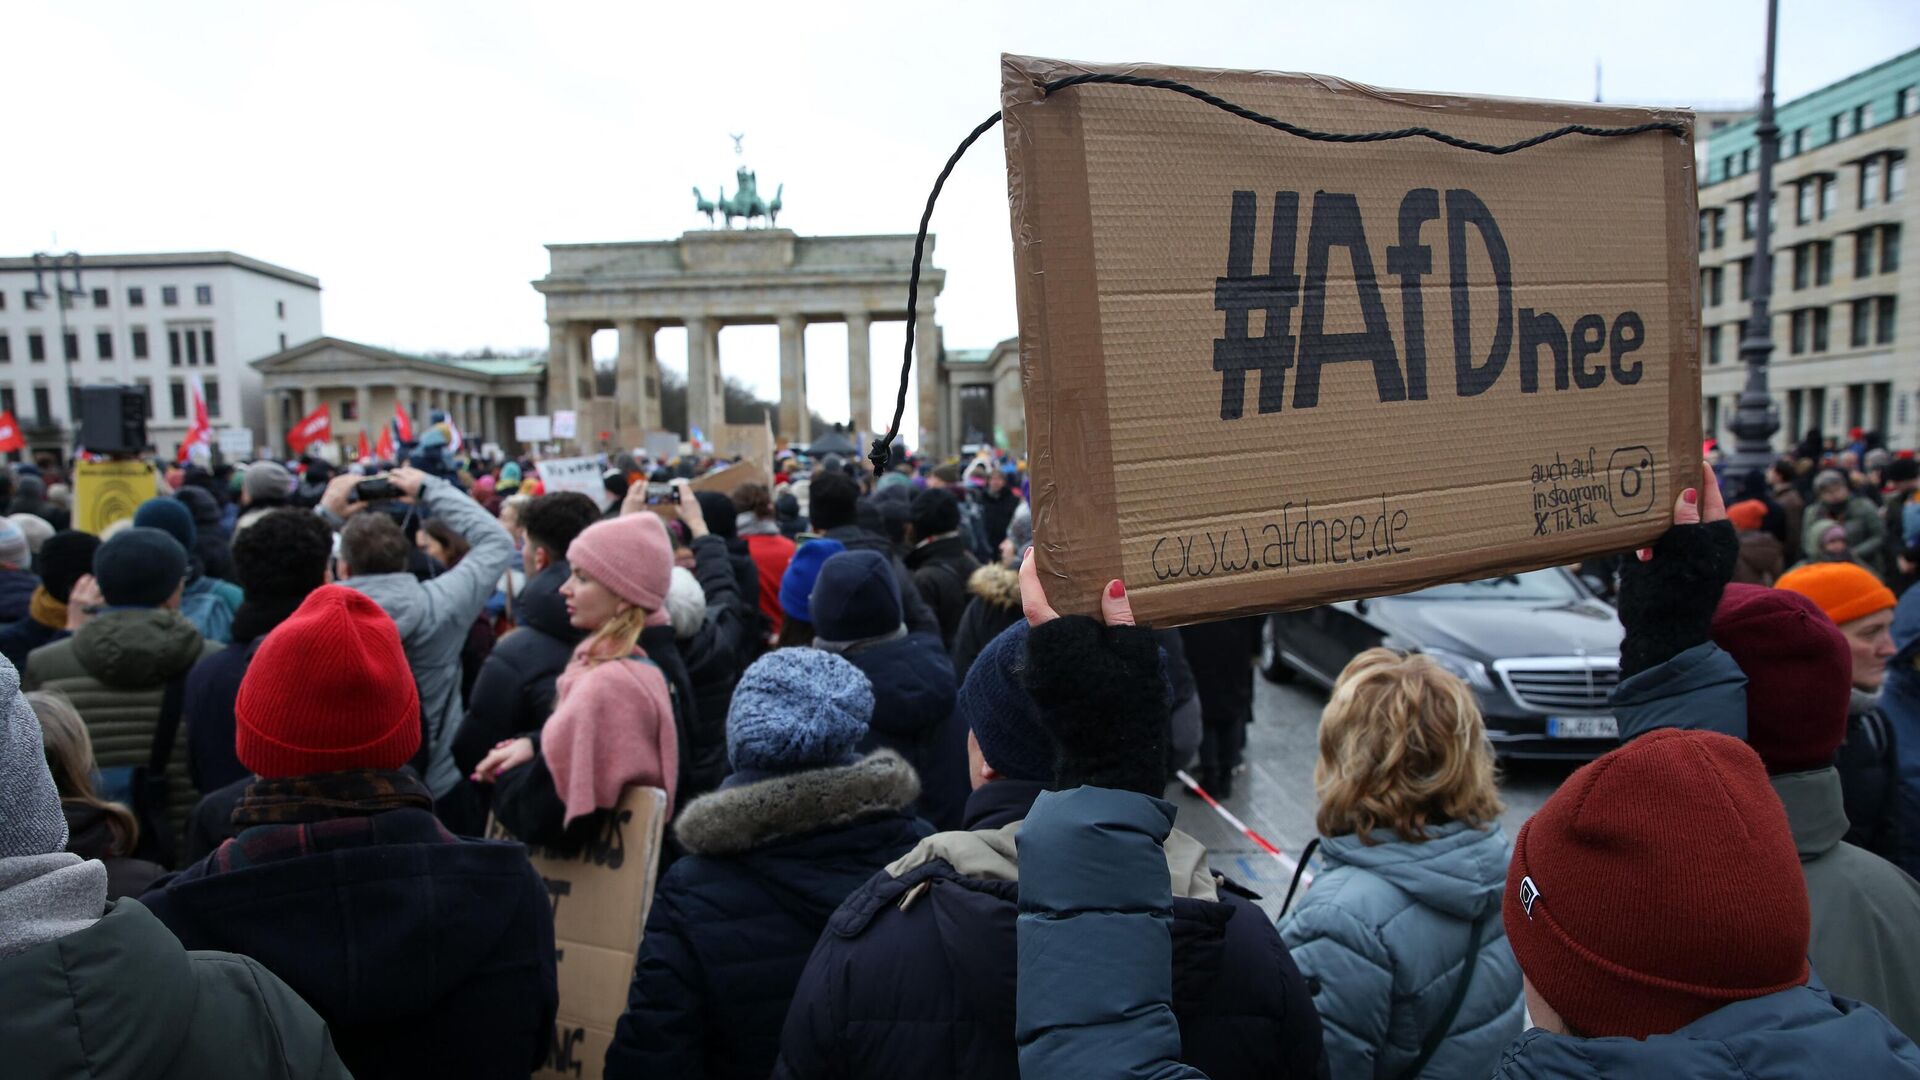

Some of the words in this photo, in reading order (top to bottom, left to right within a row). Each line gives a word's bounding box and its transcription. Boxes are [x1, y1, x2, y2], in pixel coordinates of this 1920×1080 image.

[1212, 187, 1646, 421] #AfDnee
[1531, 450, 1568, 484] auch
[1571, 446, 1597, 482] auf
[1532, 482, 1609, 511] instagram
[1151, 491, 1411, 581] www.afdnee.de
